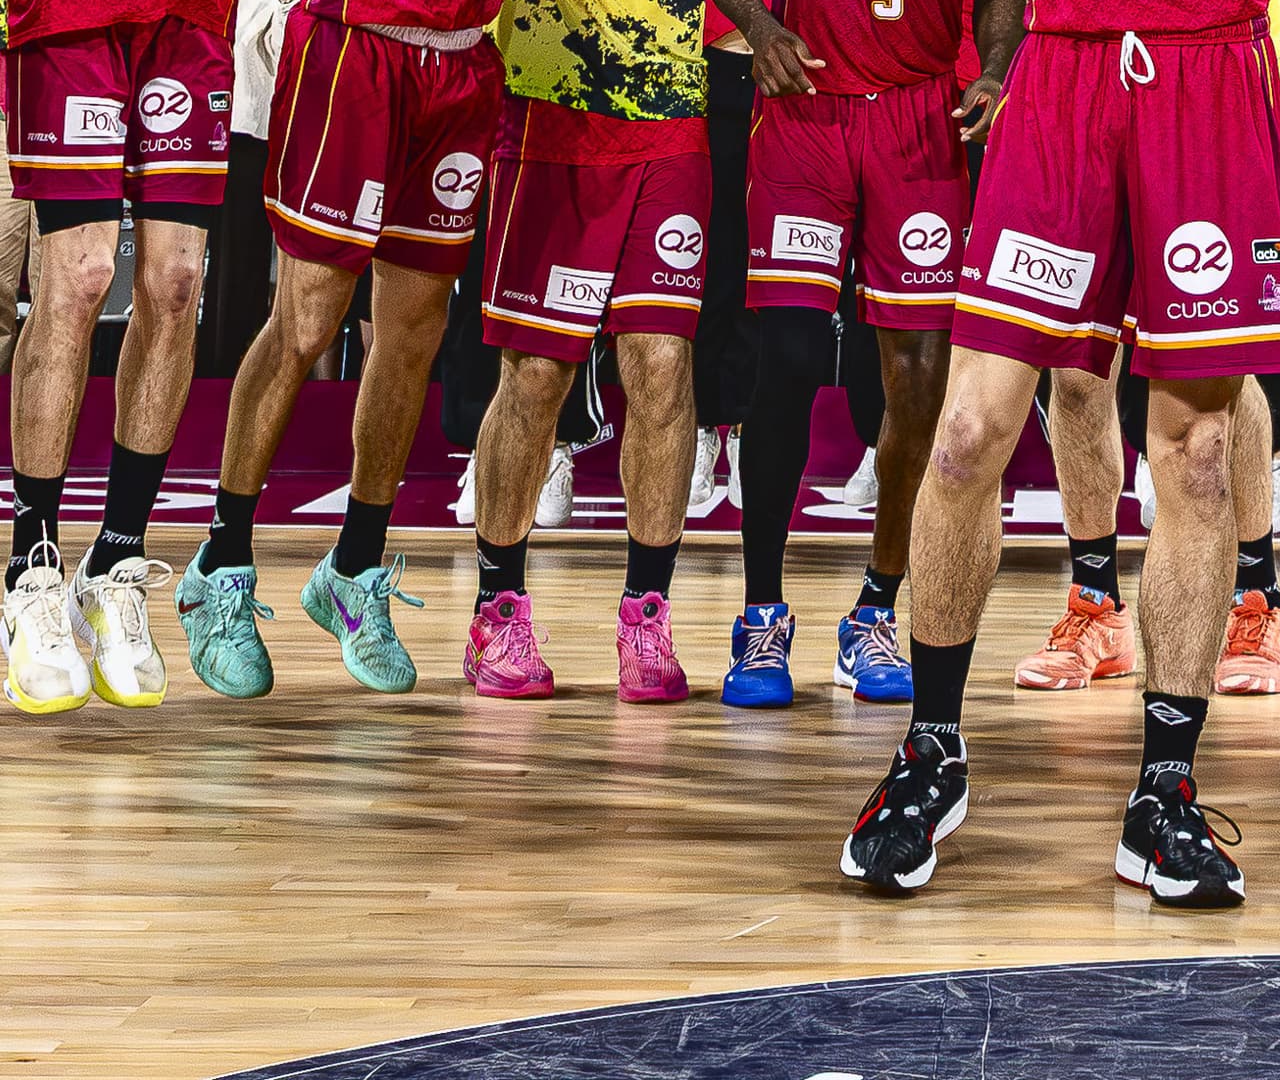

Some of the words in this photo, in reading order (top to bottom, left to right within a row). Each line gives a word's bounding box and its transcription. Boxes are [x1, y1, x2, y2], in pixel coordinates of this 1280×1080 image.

[143, 91, 189, 118] Q2
[82, 109, 119, 133] PON
[140, 135, 193, 154] CUDÓS
[434, 168, 482, 195] Q2
[428, 213, 474, 229] CUDÓ
[658, 229, 702, 256] Q2
[786, 227, 835, 252] PONS
[902, 227, 949, 251] Q2
[1167, 240, 1229, 274] Q2
[1256, 247, 1279, 261] acb
[651, 271, 702, 290] CUDÓS
[900, 268, 955, 285] CUDÓS
[1009, 248, 1077, 290] PONS
[560, 279, 612, 305] PONS
[1166, 296, 1240, 321] CUDÓS
